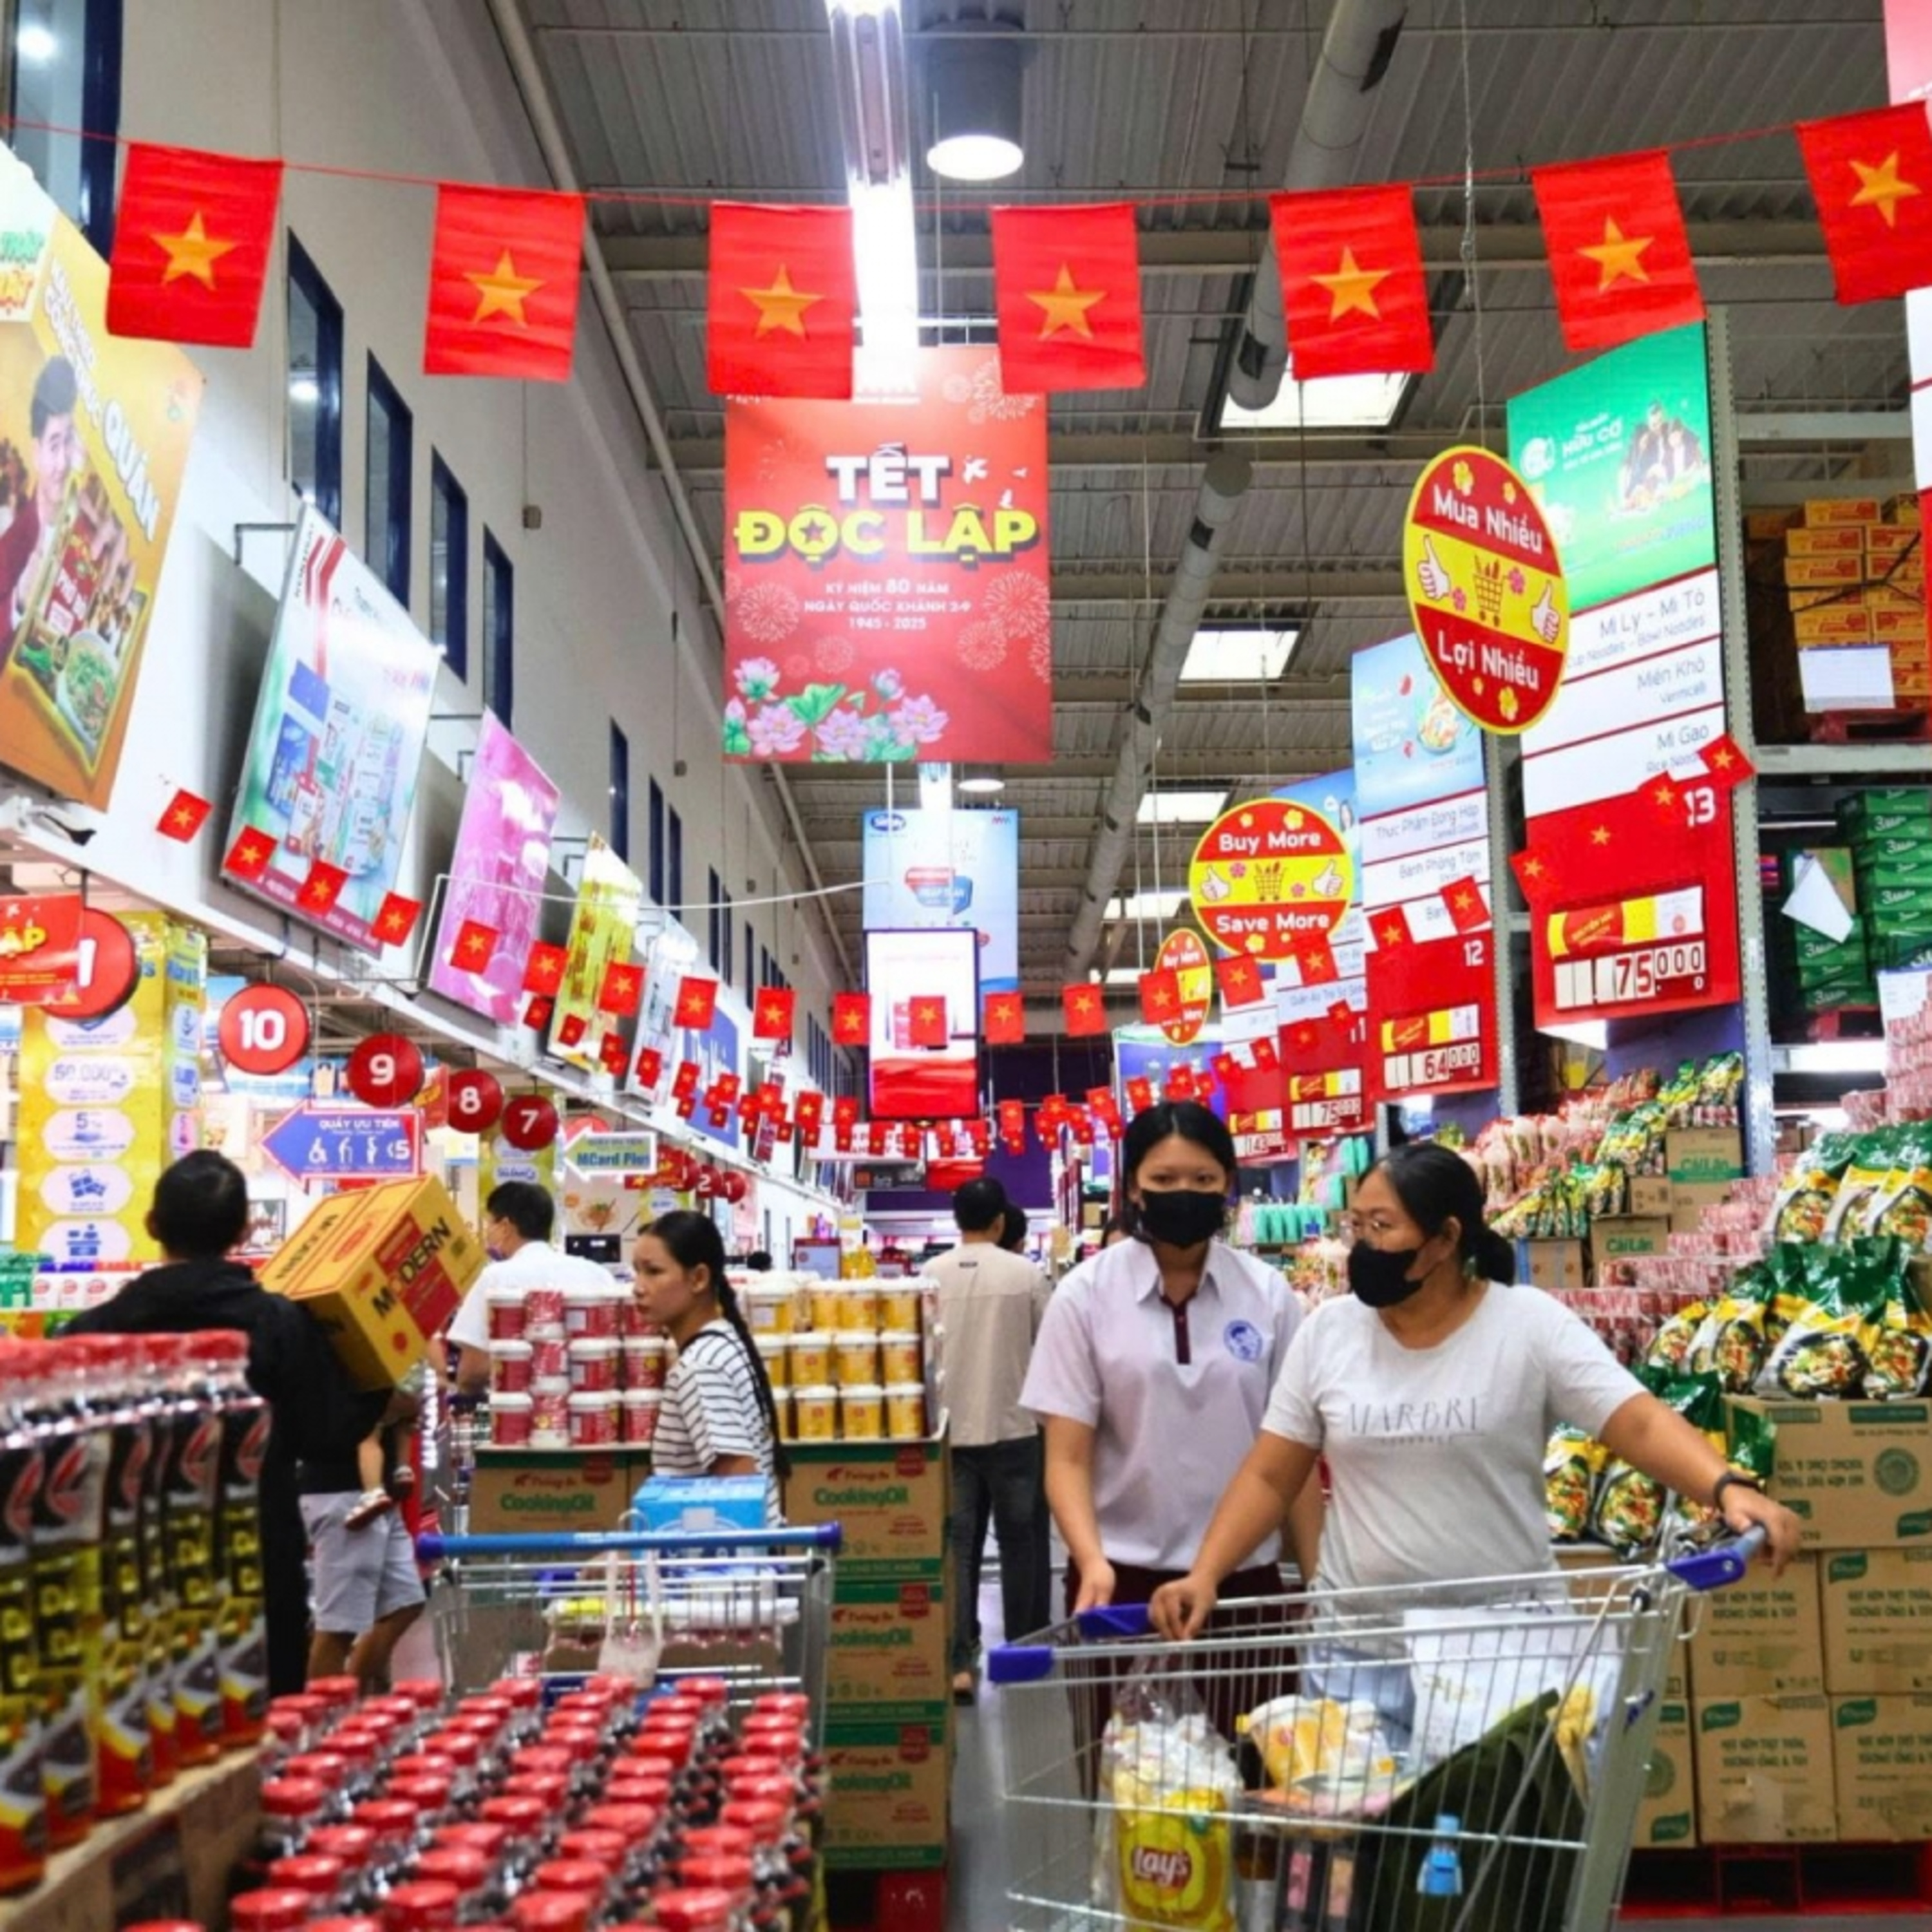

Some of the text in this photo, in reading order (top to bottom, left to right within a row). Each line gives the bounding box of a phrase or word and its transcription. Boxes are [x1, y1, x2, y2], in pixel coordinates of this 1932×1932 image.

[826, 442, 951, 504] TẾT
[734, 502, 1039, 563] ĐỘC LẬP
[1433, 485, 1543, 554] Mua Nhiều
[886, 578, 910, 594] 80
[849, 618, 881, 630] 1945
[893, 618, 927, 630] 2025
[1620, 612, 1641, 634] Ly
[1438, 630, 1539, 691] Lợi Nhiều
[1683, 786, 1716, 828] 13
[1219, 829, 1321, 855] Buy More
[1216, 914, 1269, 933] Save
[1275, 911, 1331, 931] More
[0, 925, 47, 957] ẬP
[1464, 939, 1484, 967] 12
[78, 938, 97, 987] 1
[238, 1009, 287, 1051] 10
[369, 1053, 395, 1085] 9
[458, 1086, 482, 1114] 8
[76, 1112, 89, 1129] 5
[520, 1110, 539, 1134] 7
[577, 1151, 620, 1166] MCard
[698, 1174, 712, 1192] 2
[724, 1181, 733, 1195] 1
[830, 1627, 913, 1651] ookingOil
[831, 1771, 912, 1794] ookingOil
[1133, 1847, 1189, 1887] Lay's
